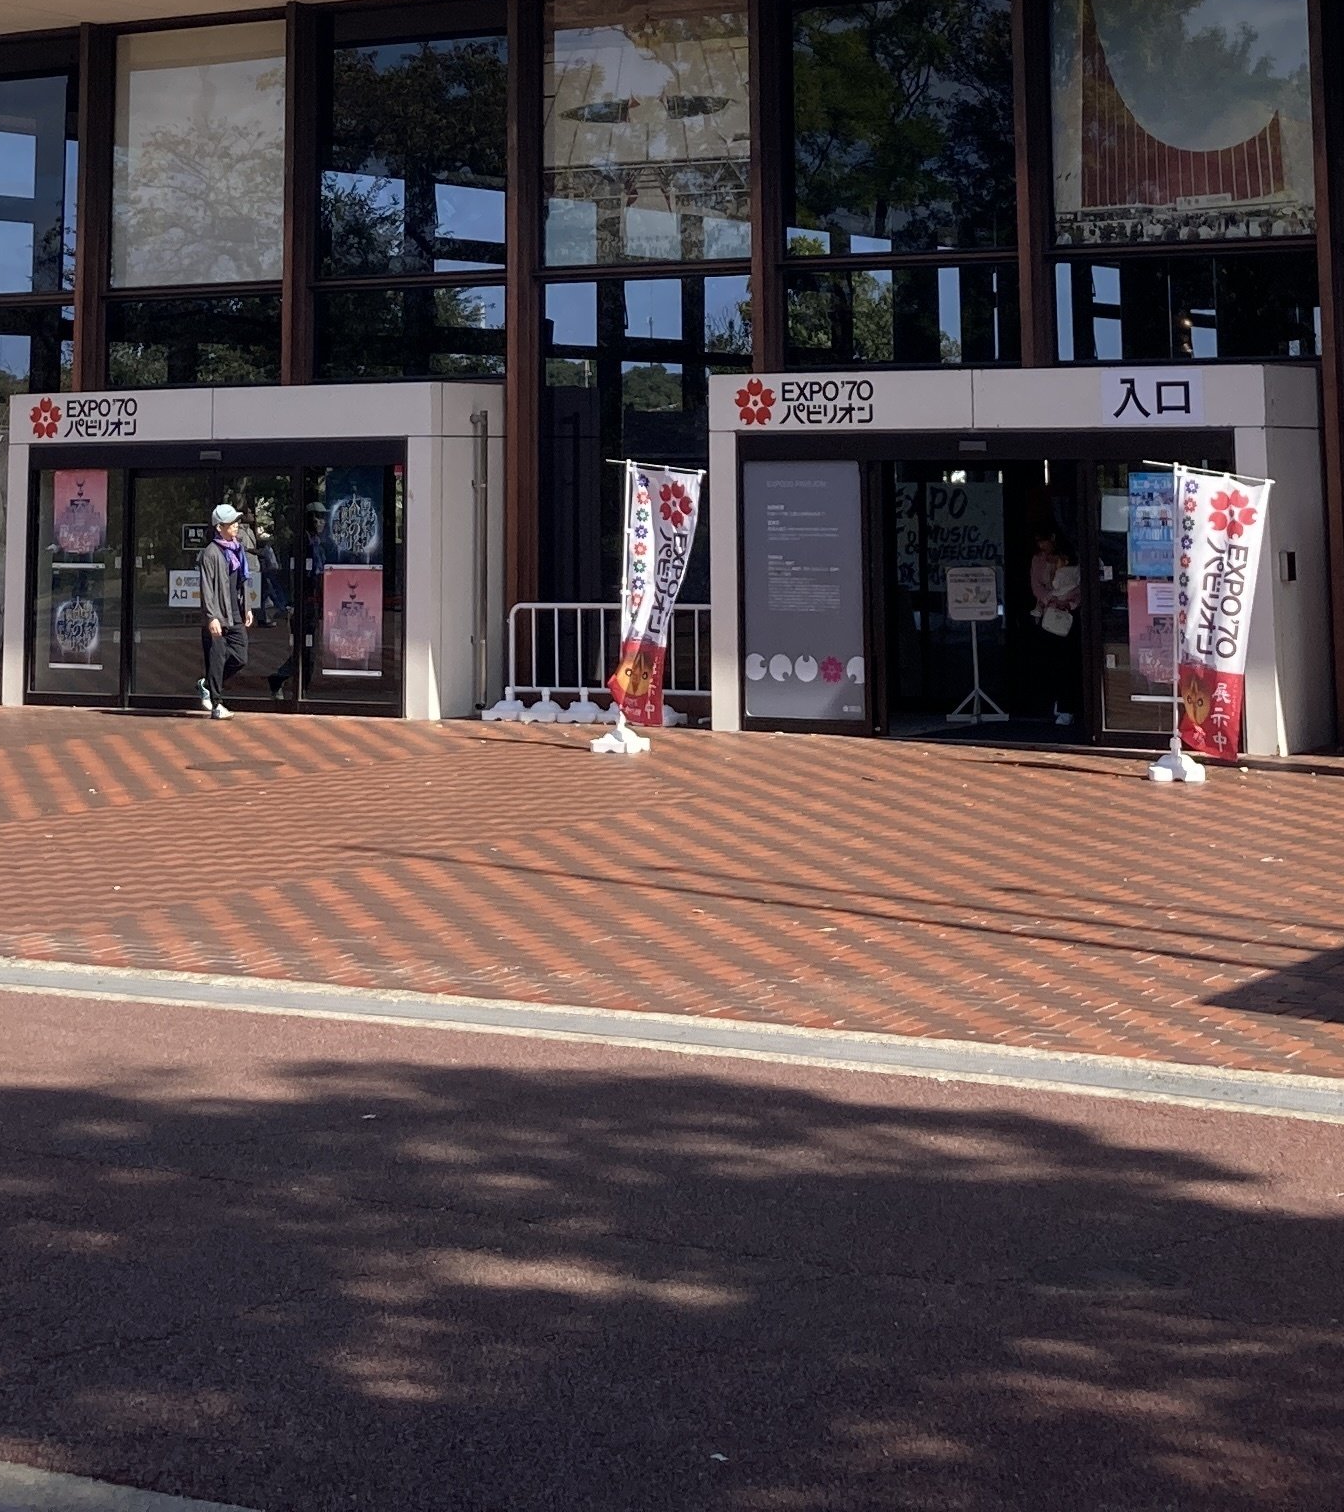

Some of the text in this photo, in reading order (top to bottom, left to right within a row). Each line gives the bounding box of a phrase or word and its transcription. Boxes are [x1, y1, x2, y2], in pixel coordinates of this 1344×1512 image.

[781, 379, 874, 402] EXPO'70
[1113, 378, 1191, 418] 入口
[66, 398, 138, 418] EXPO'70
[779, 402, 874, 424] パビリオン
[64, 418, 137, 438] パビリオン
[928, 525, 981, 543] MUSIC
[172, 590, 188, 600] 入口
[1196, 537, 1225, 655] パビリオン
[1215, 544, 1249, 659] EXPO'70
[1210, 682, 1232, 753] 展示中
